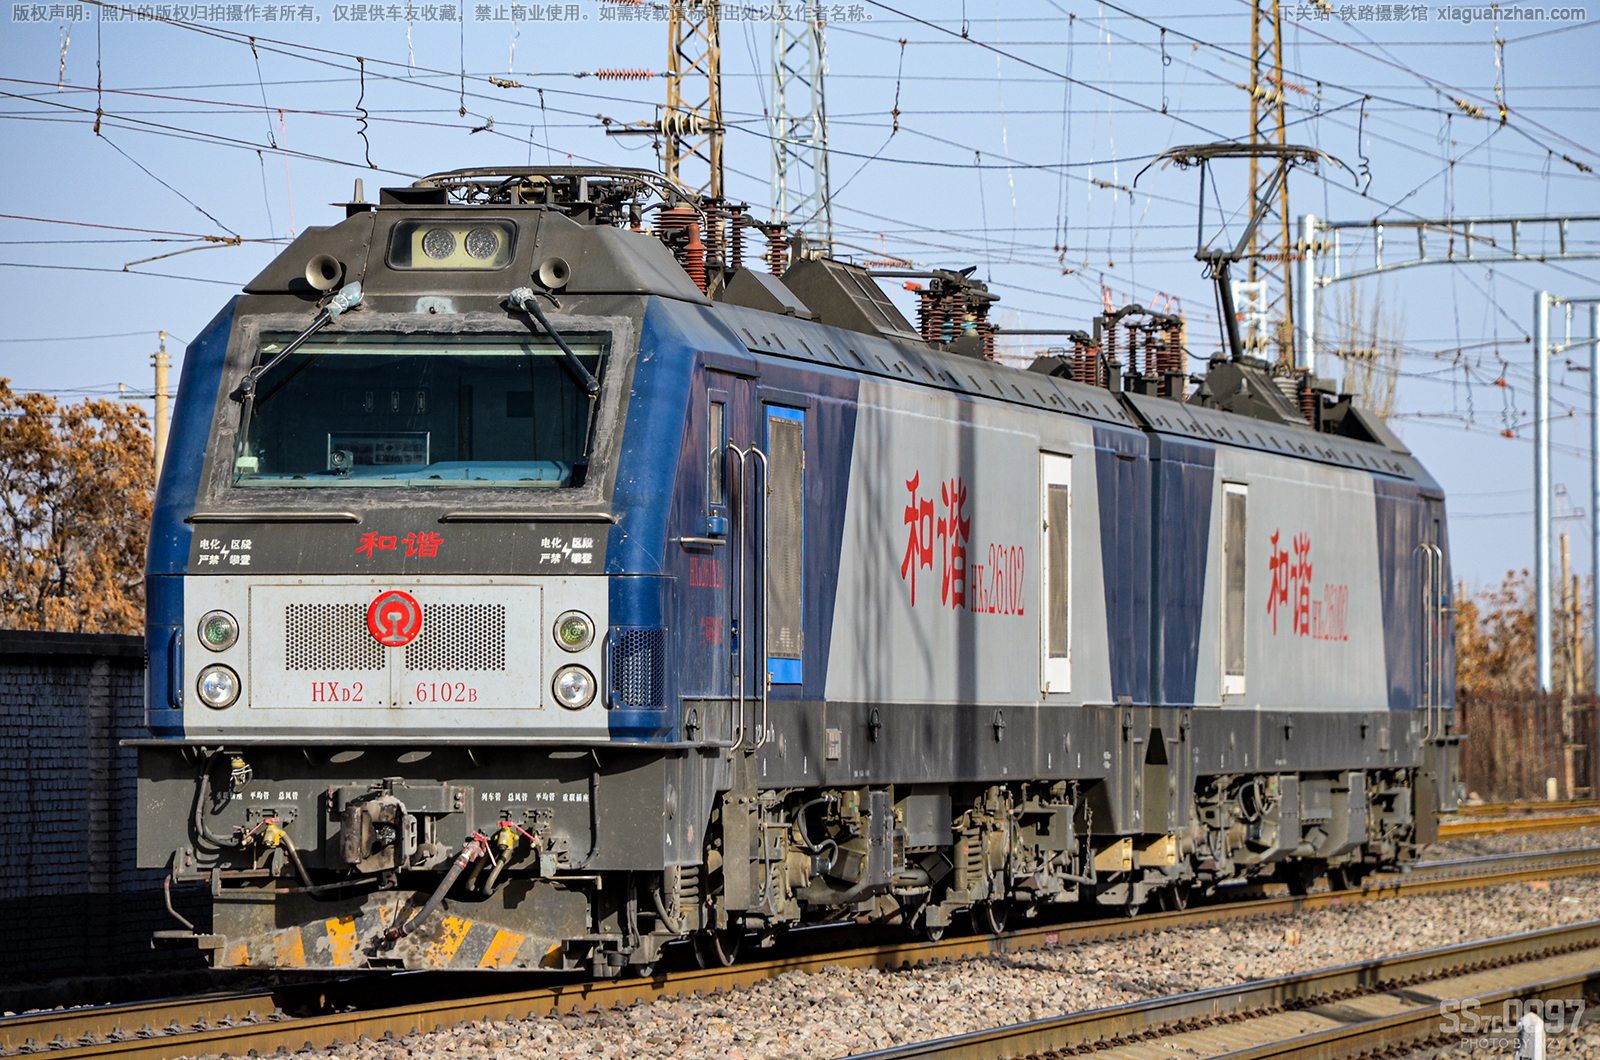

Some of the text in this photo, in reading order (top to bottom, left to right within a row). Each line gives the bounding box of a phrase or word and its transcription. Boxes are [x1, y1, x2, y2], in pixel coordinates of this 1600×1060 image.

[199, 538, 221, 550] 电化
[355, 531, 445, 559] 和谐
[540, 536, 562, 549] 电化
[900, 468, 971, 611] 和谐
[1266, 526, 1313, 638] 和谐
[311, 680, 479, 703] HXD2 6102B
